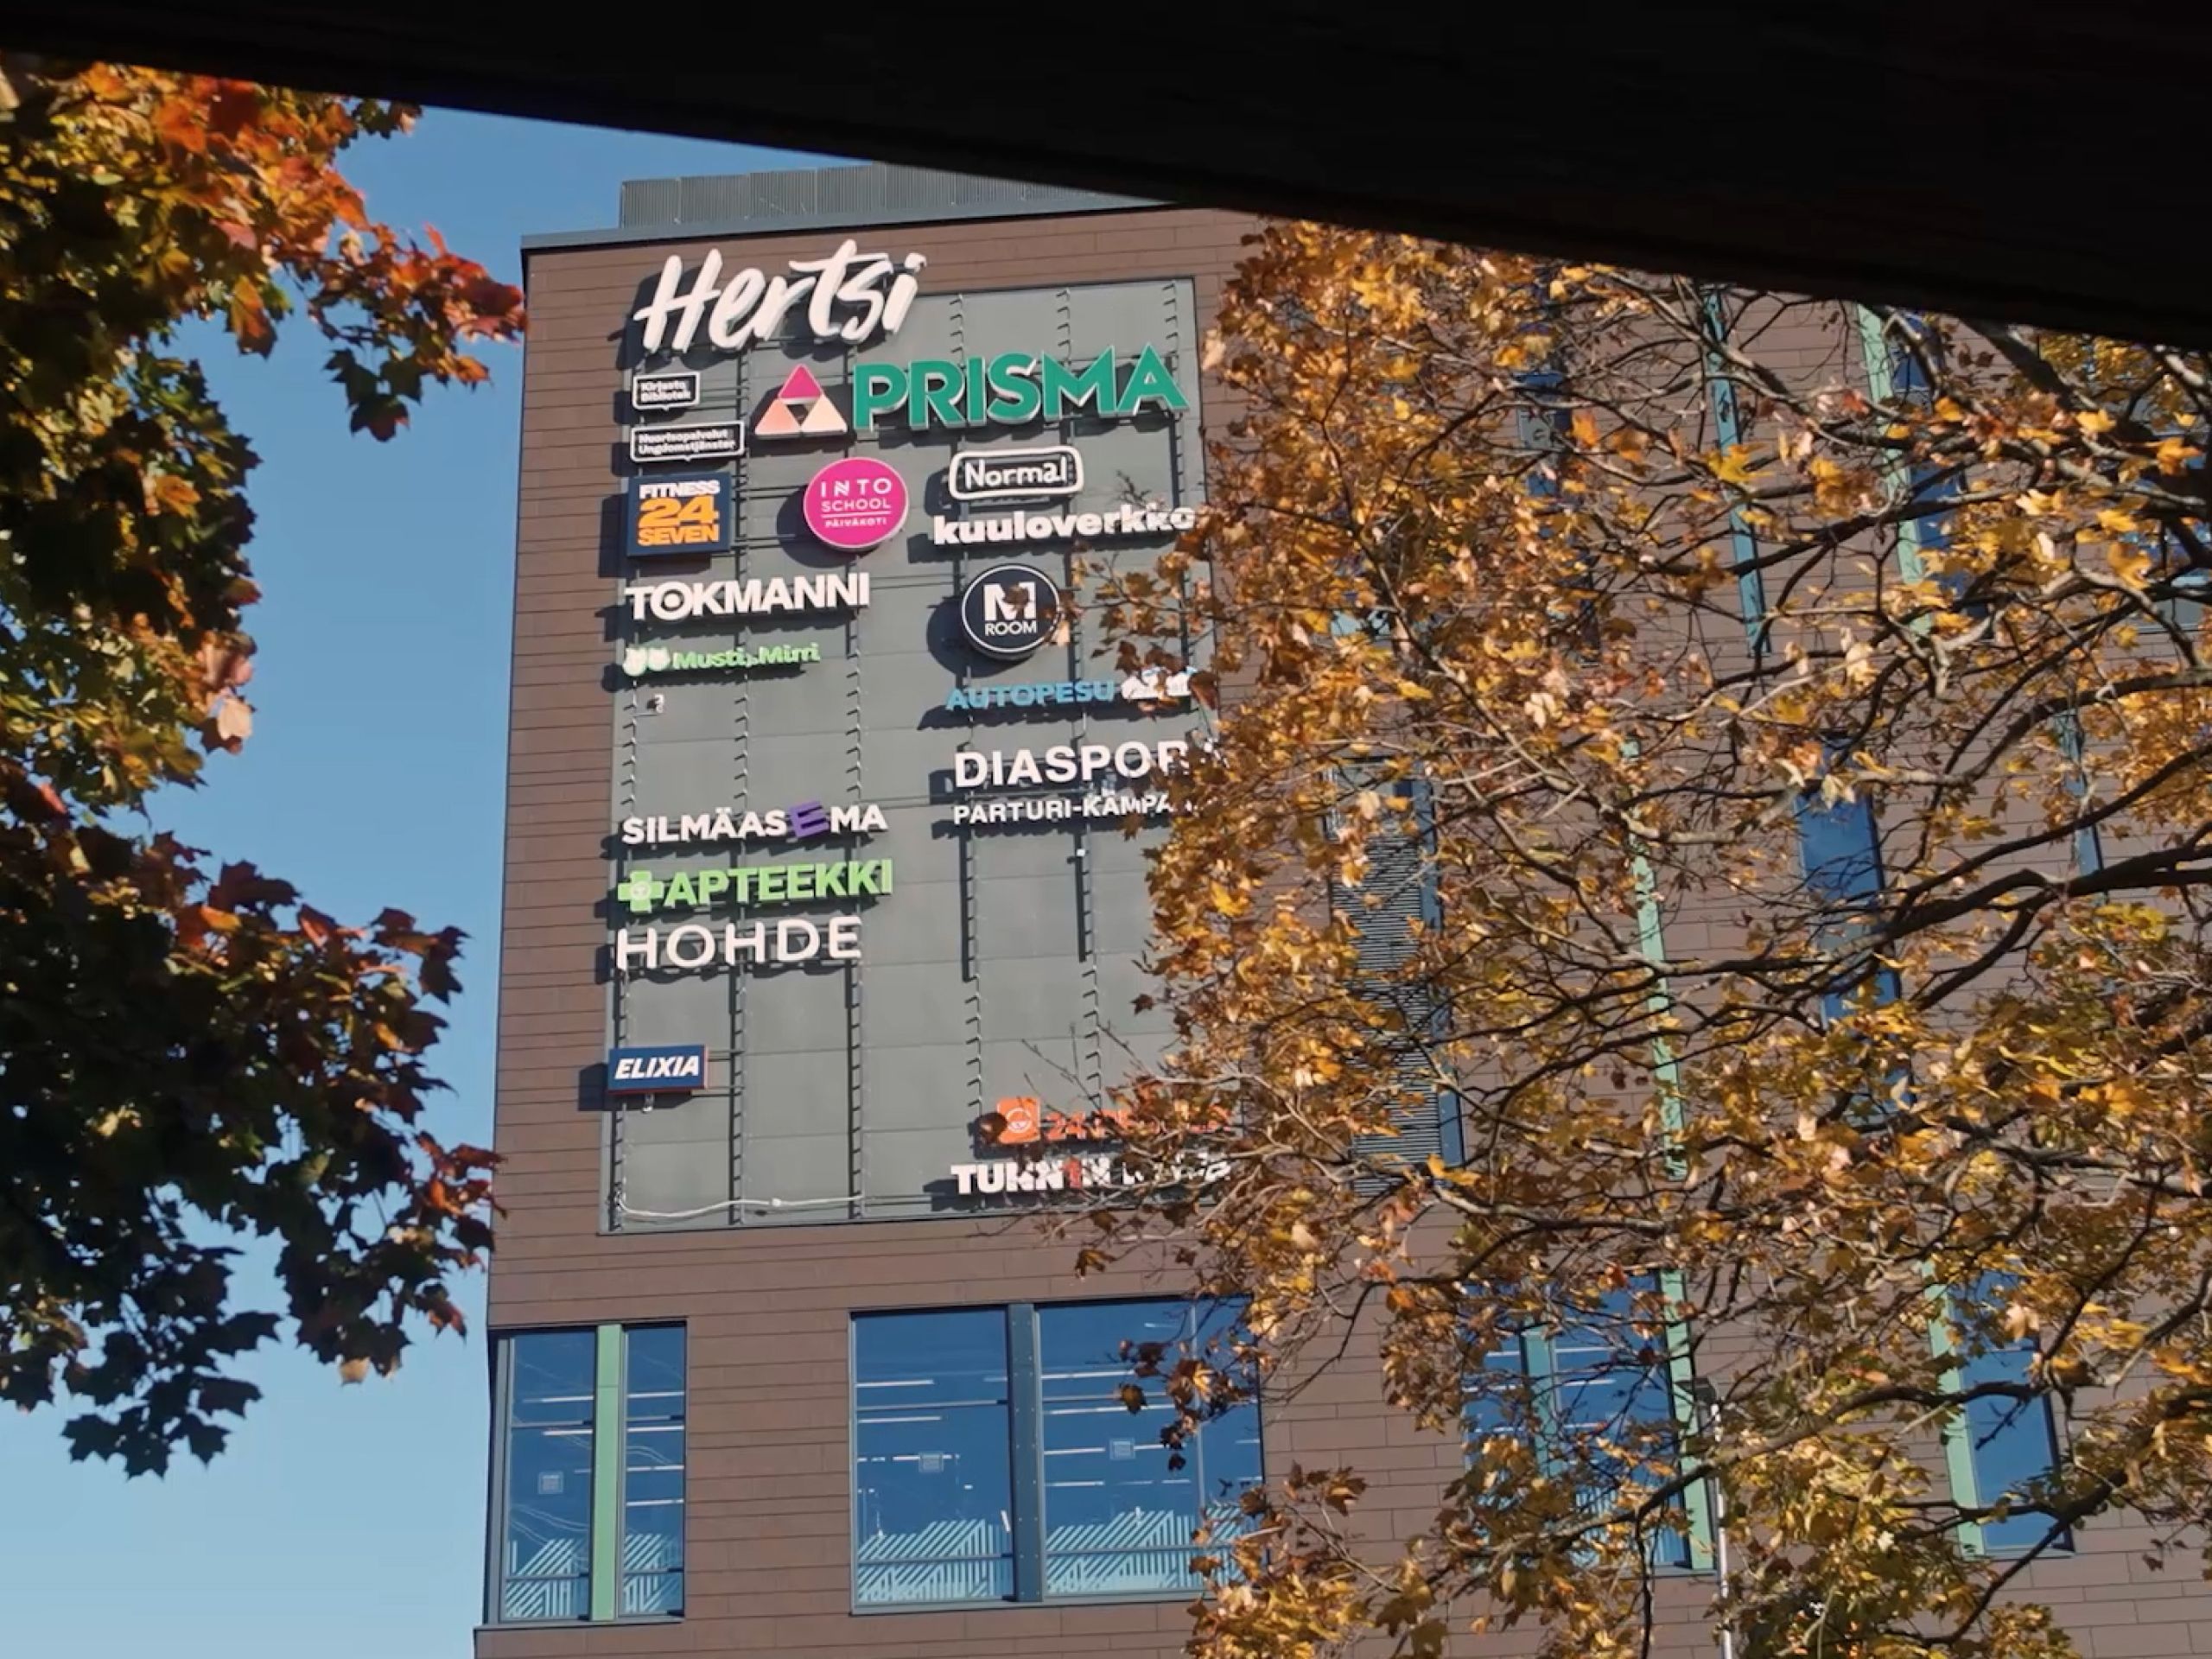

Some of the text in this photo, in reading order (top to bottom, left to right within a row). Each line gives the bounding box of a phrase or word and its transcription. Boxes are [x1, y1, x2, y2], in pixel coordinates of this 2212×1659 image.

[633, 238, 927, 353] Hertsi
[853, 344, 1190, 431] PRISMA
[639, 480, 721, 499] FITNESS
[820, 477, 892, 499] INTO
[964, 455, 1068, 490] Normal
[638, 493, 720, 528] 24
[820, 497, 893, 512] SCHOOL
[637, 523, 720, 547] SEVEN
[934, 503, 1196, 545] kuuloverkko
[625, 572, 870, 621] TOKMANNI
[983, 620, 1039, 638] ROOM
[946, 679, 1115, 710] AUTOPESU
[955, 737, 1230, 788] DIASPOR
[622, 800, 888, 845] SILMÄASEMA
[664, 859, 893, 907] APTEEKKI
[617, 915, 862, 971] HOHDE
[614, 1055, 699, 1080] ELIXIA
